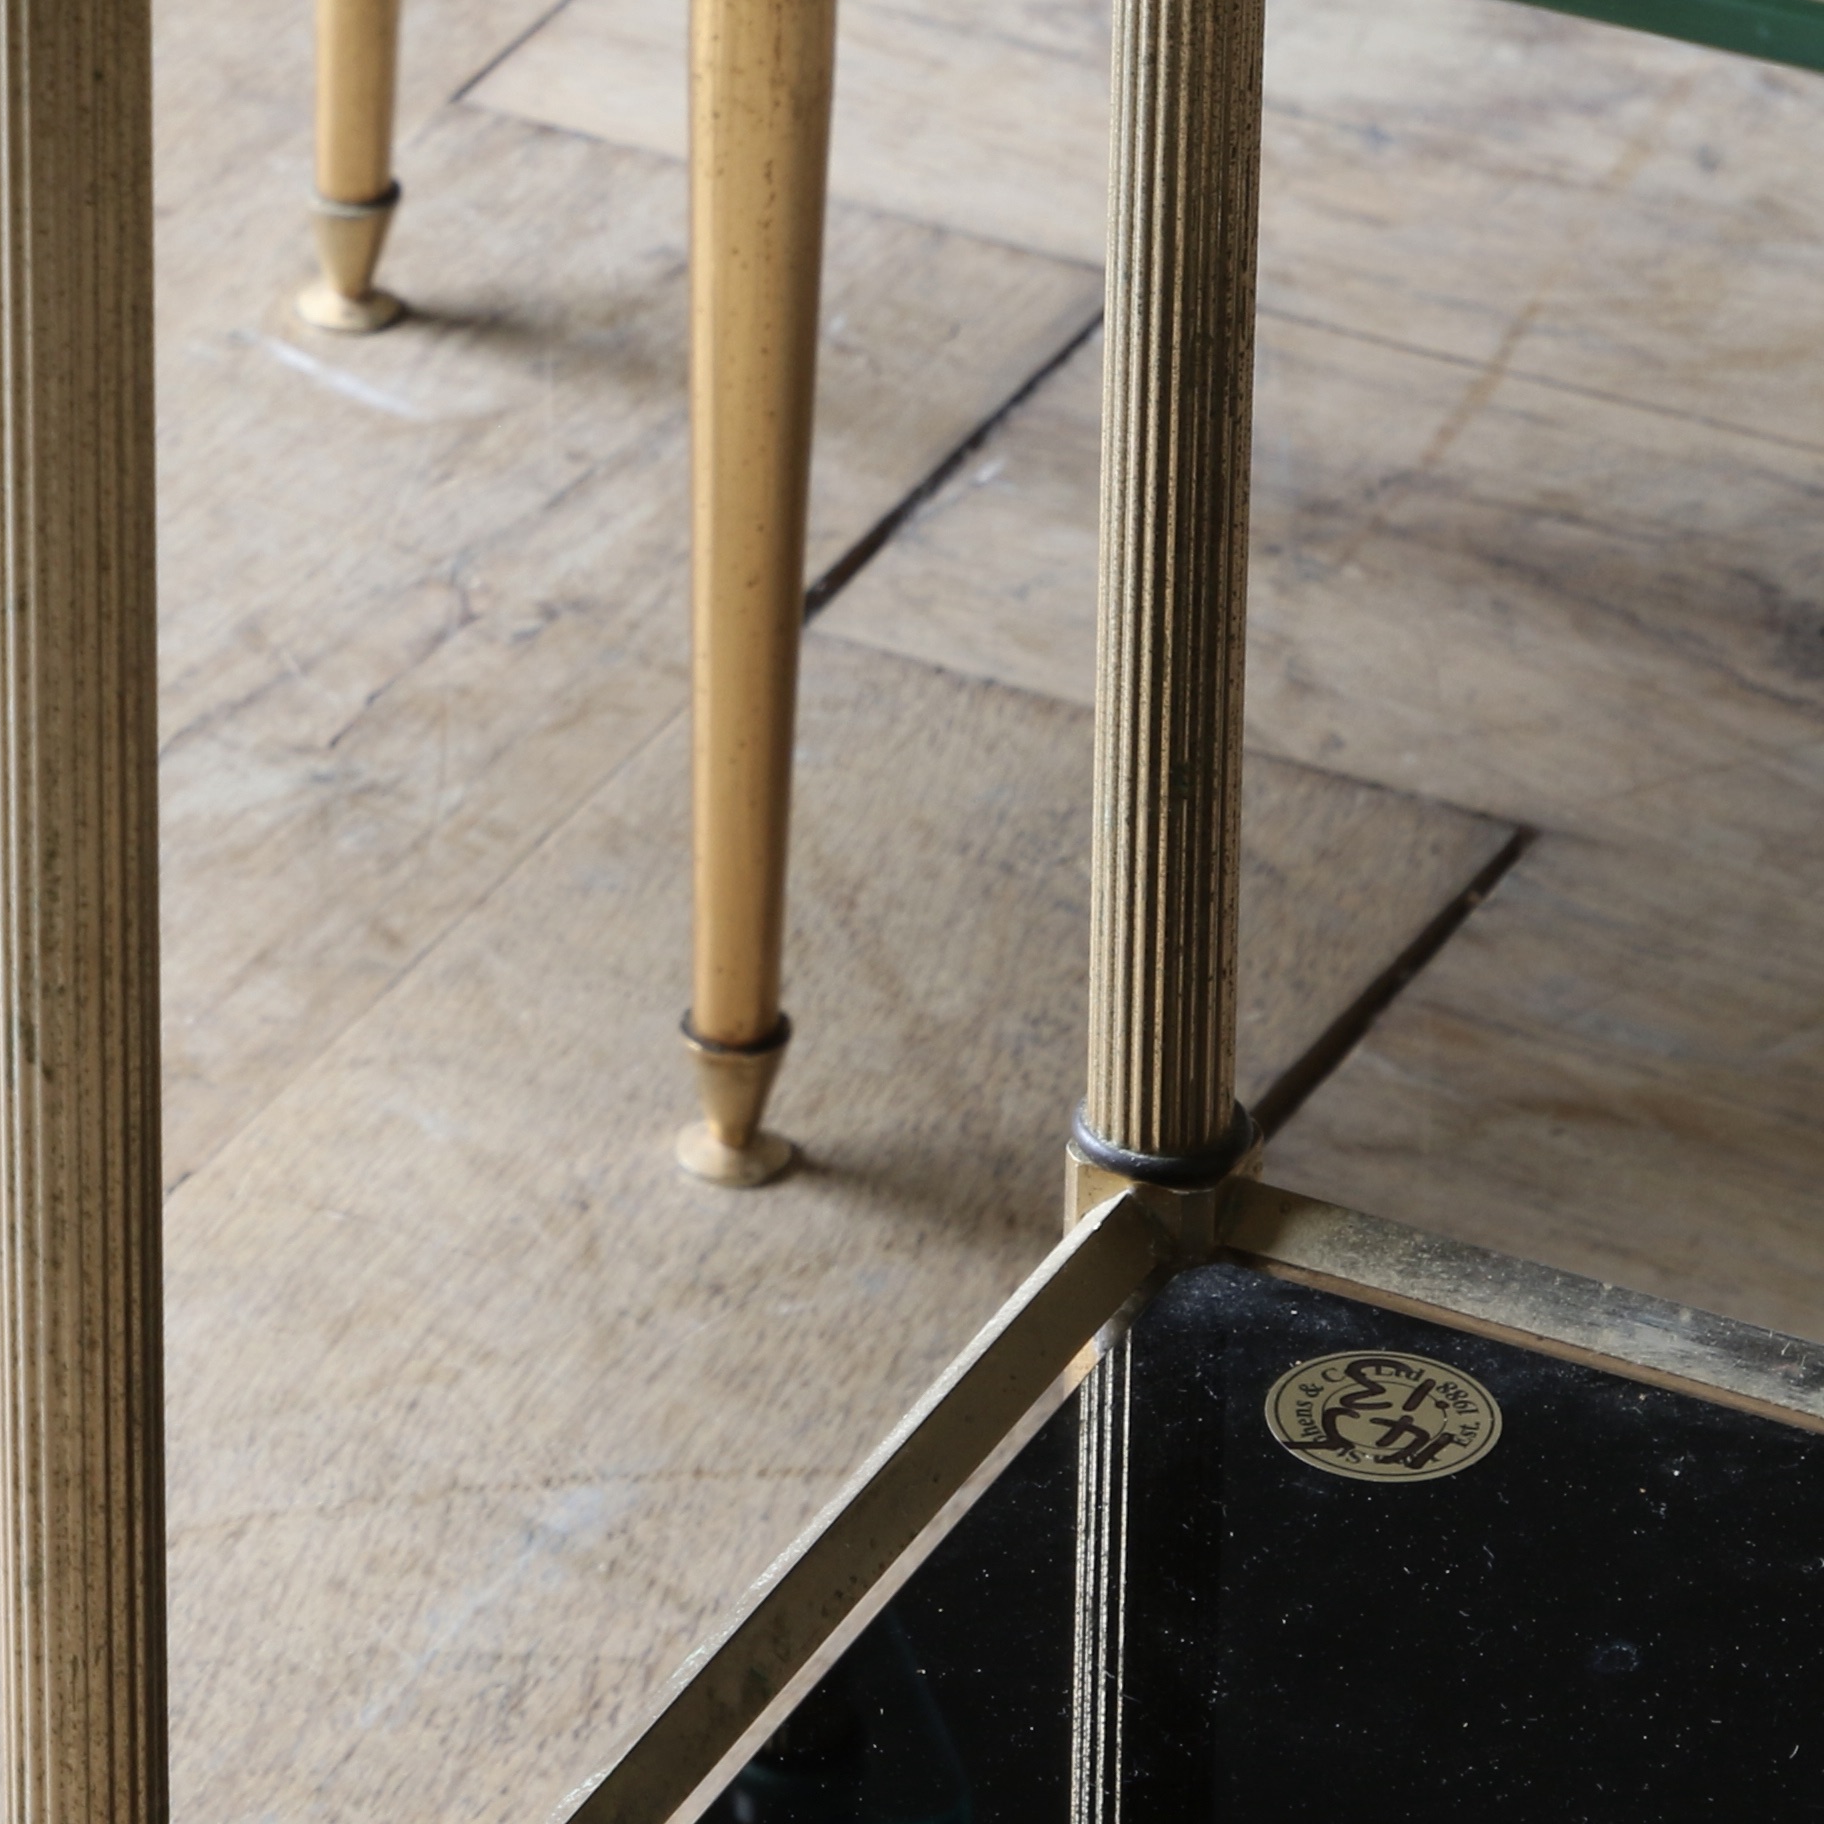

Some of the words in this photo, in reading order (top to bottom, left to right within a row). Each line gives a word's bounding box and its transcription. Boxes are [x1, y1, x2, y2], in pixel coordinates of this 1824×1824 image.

[1340, 1358, 1436, 1411] 13
[1436, 1380, 1481, 1416] 1988
[1282, 1407, 1455, 1469] 145
